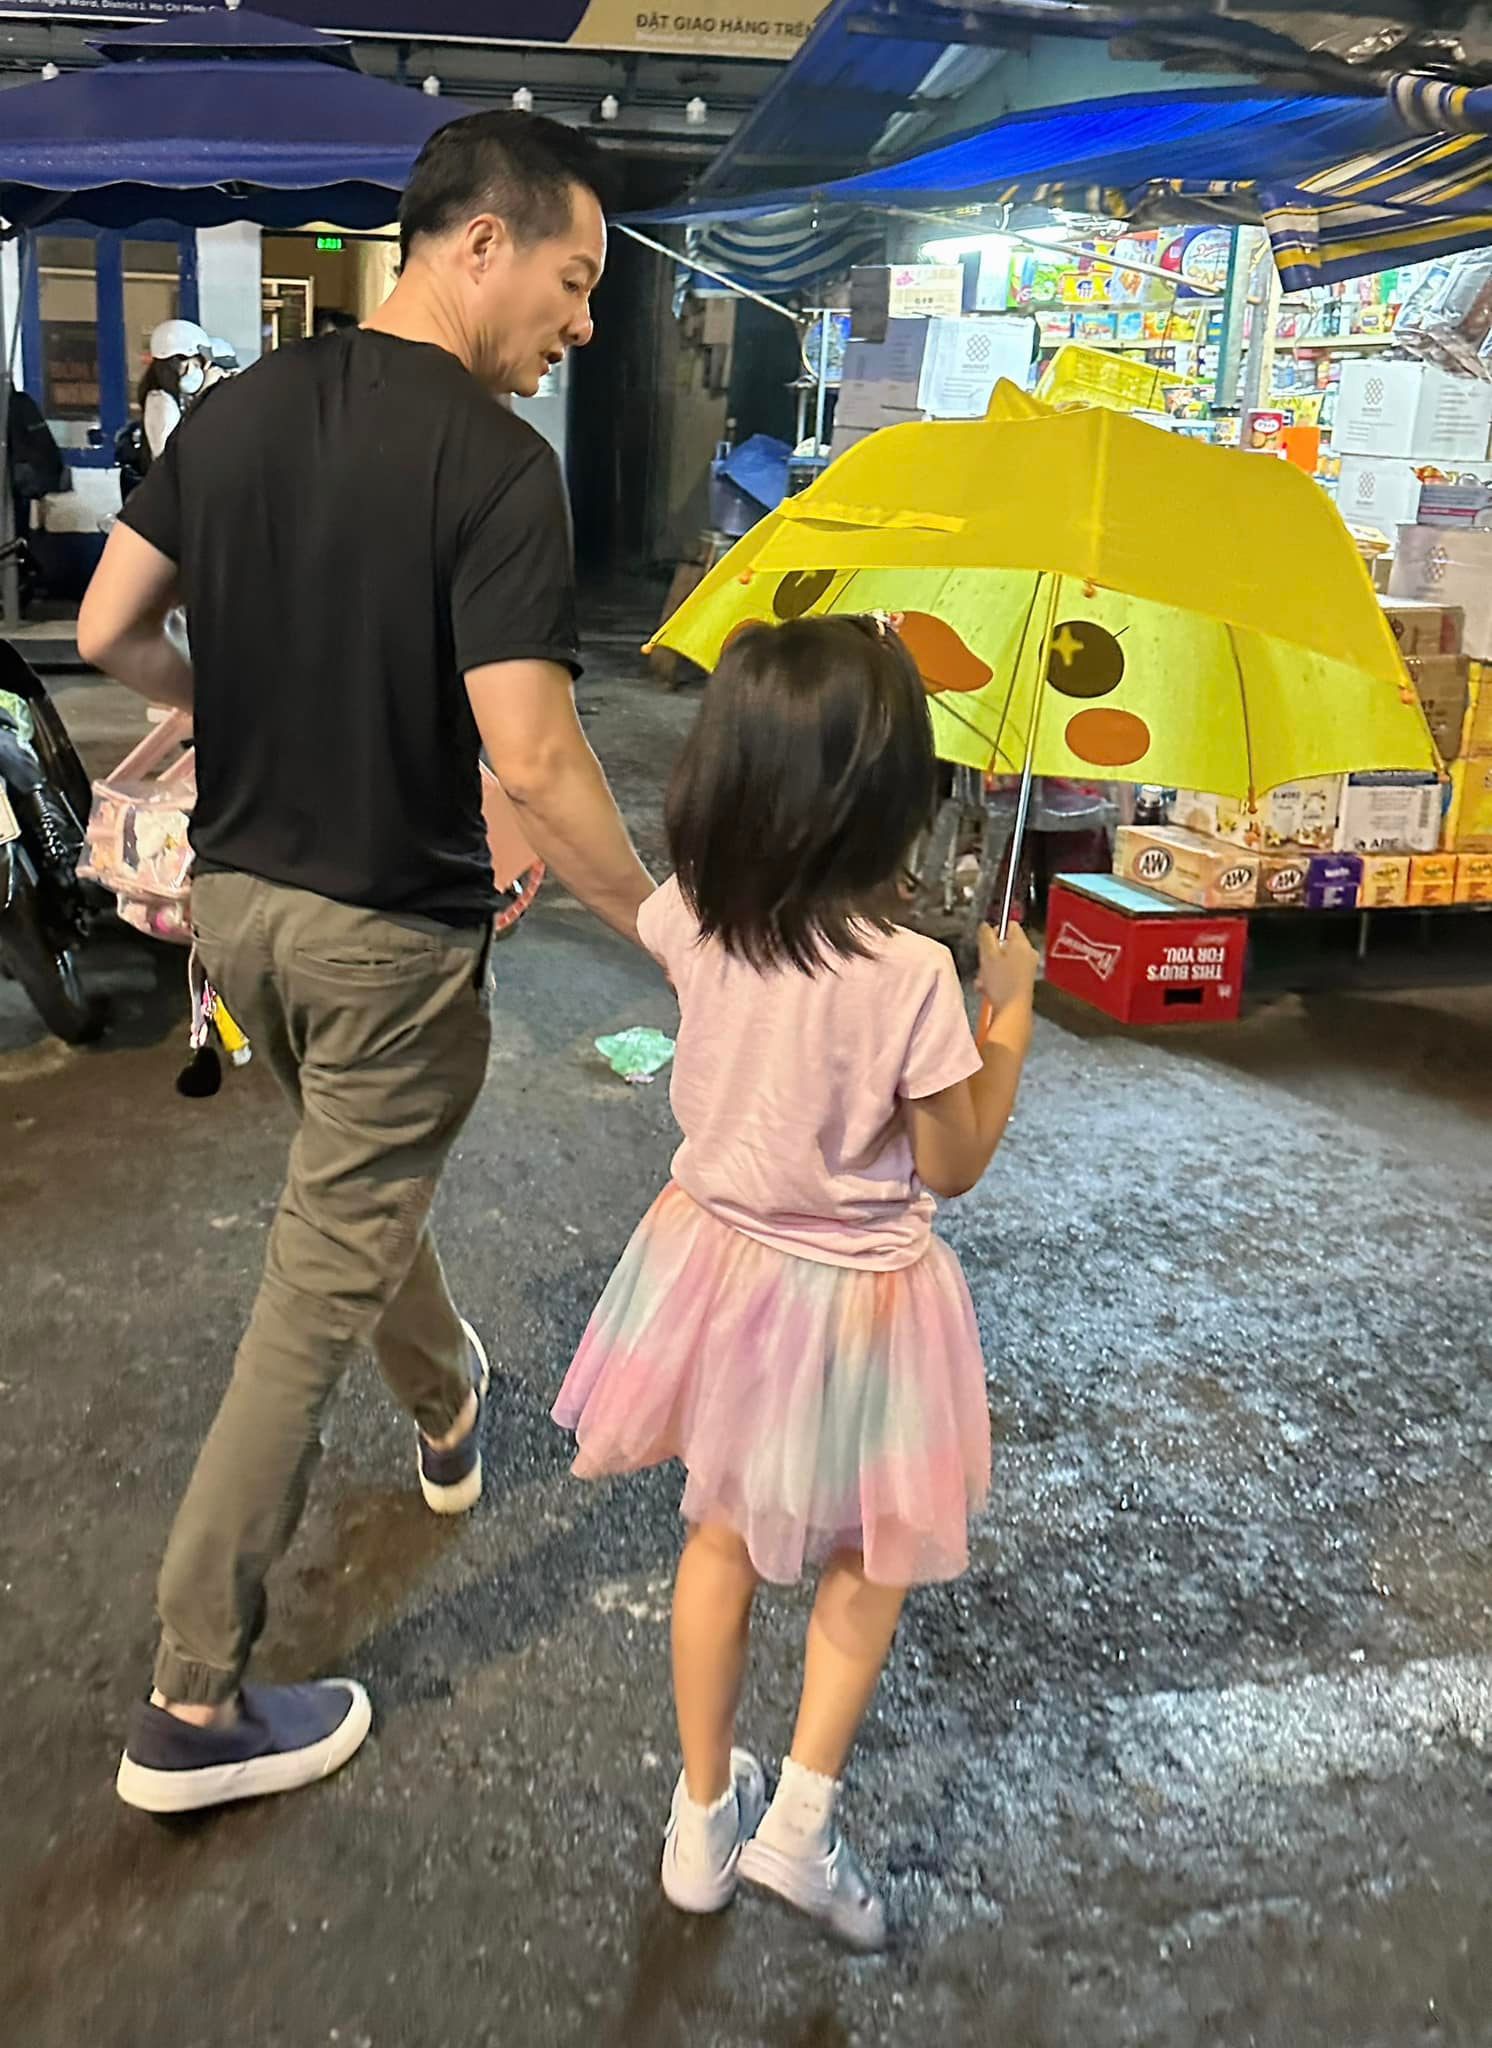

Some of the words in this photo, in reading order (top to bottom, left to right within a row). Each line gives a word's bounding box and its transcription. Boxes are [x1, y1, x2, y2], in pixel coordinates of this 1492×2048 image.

[673, 16, 716, 32] GIAO
[719, 17, 769, 35] HÀNG
[1163, 947, 1194, 963] YOU.
[1197, 947, 1225, 963] FOR
[1146, 965, 1188, 981] BUD'S
[1191, 965, 1222, 980] THIS
